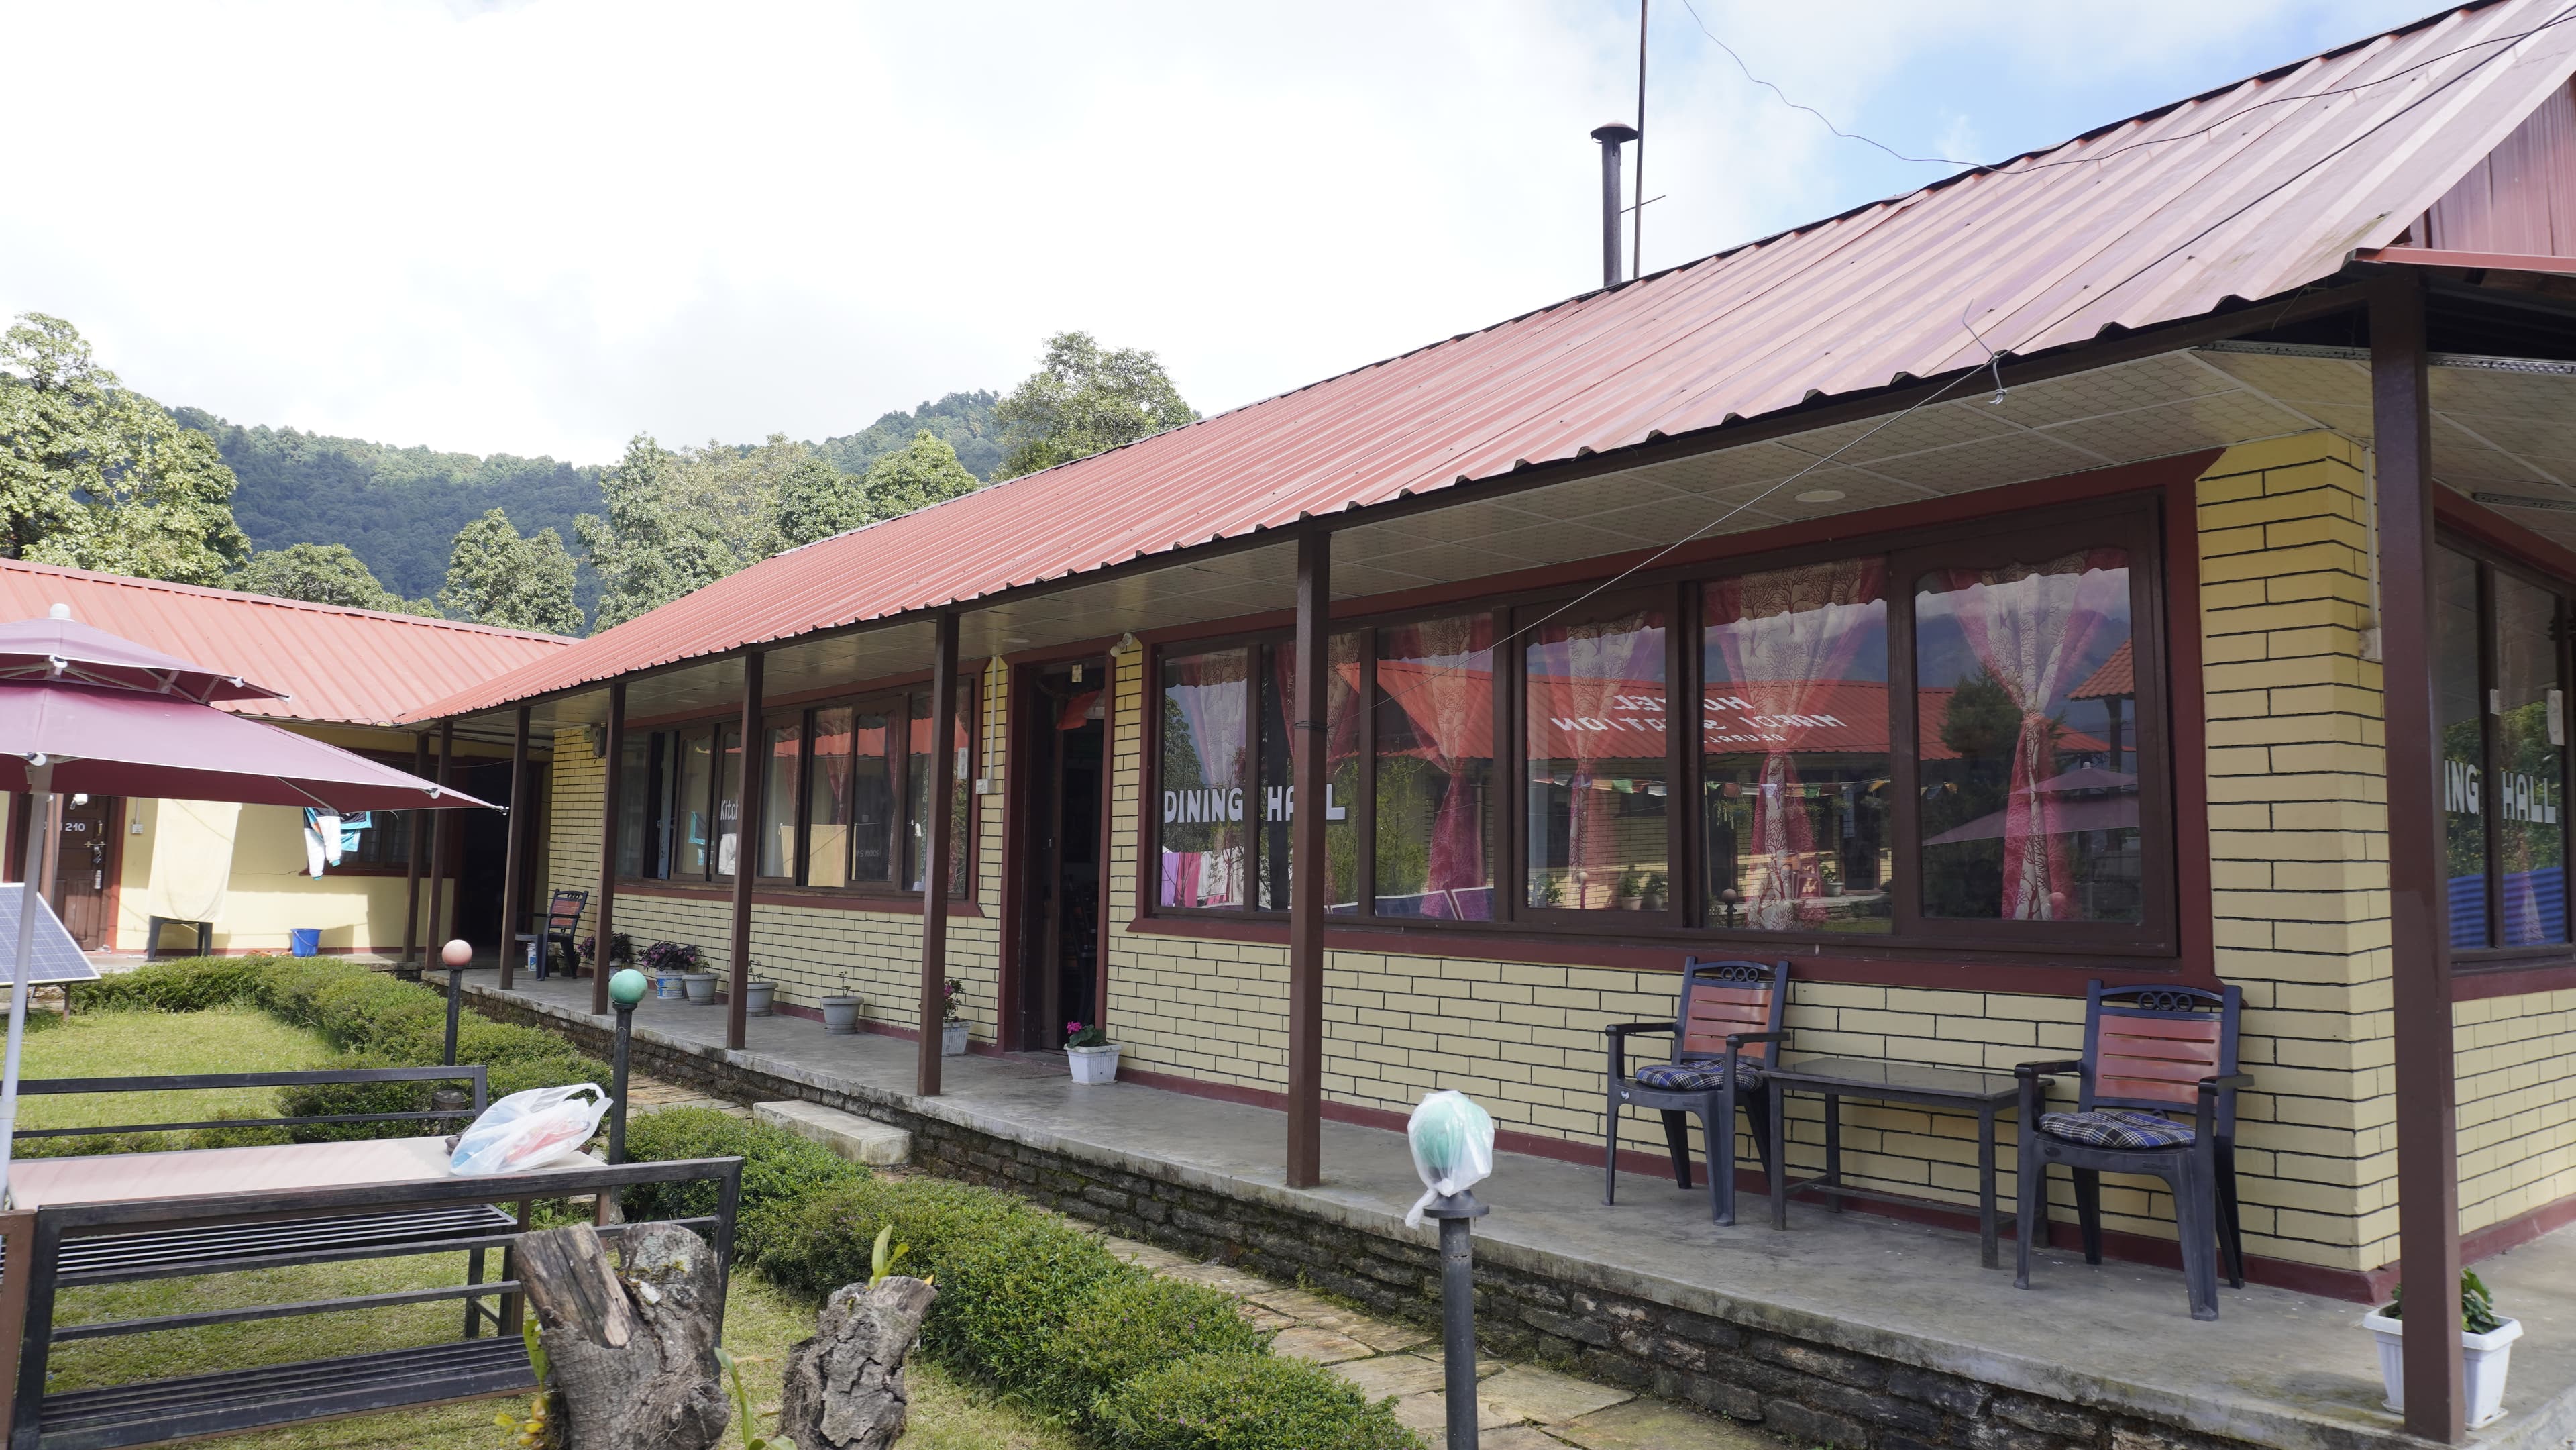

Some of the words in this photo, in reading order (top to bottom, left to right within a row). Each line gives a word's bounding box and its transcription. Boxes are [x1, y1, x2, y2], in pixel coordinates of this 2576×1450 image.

[1164, 788, 1243, 823] DINING
[1267, 783, 1346, 822] HAL
[2444, 760, 2479, 815] ING
[2502, 771, 2557, 824] HALL
[720, 798, 739, 821] Kitch
[65, 822, 85, 831] 210
